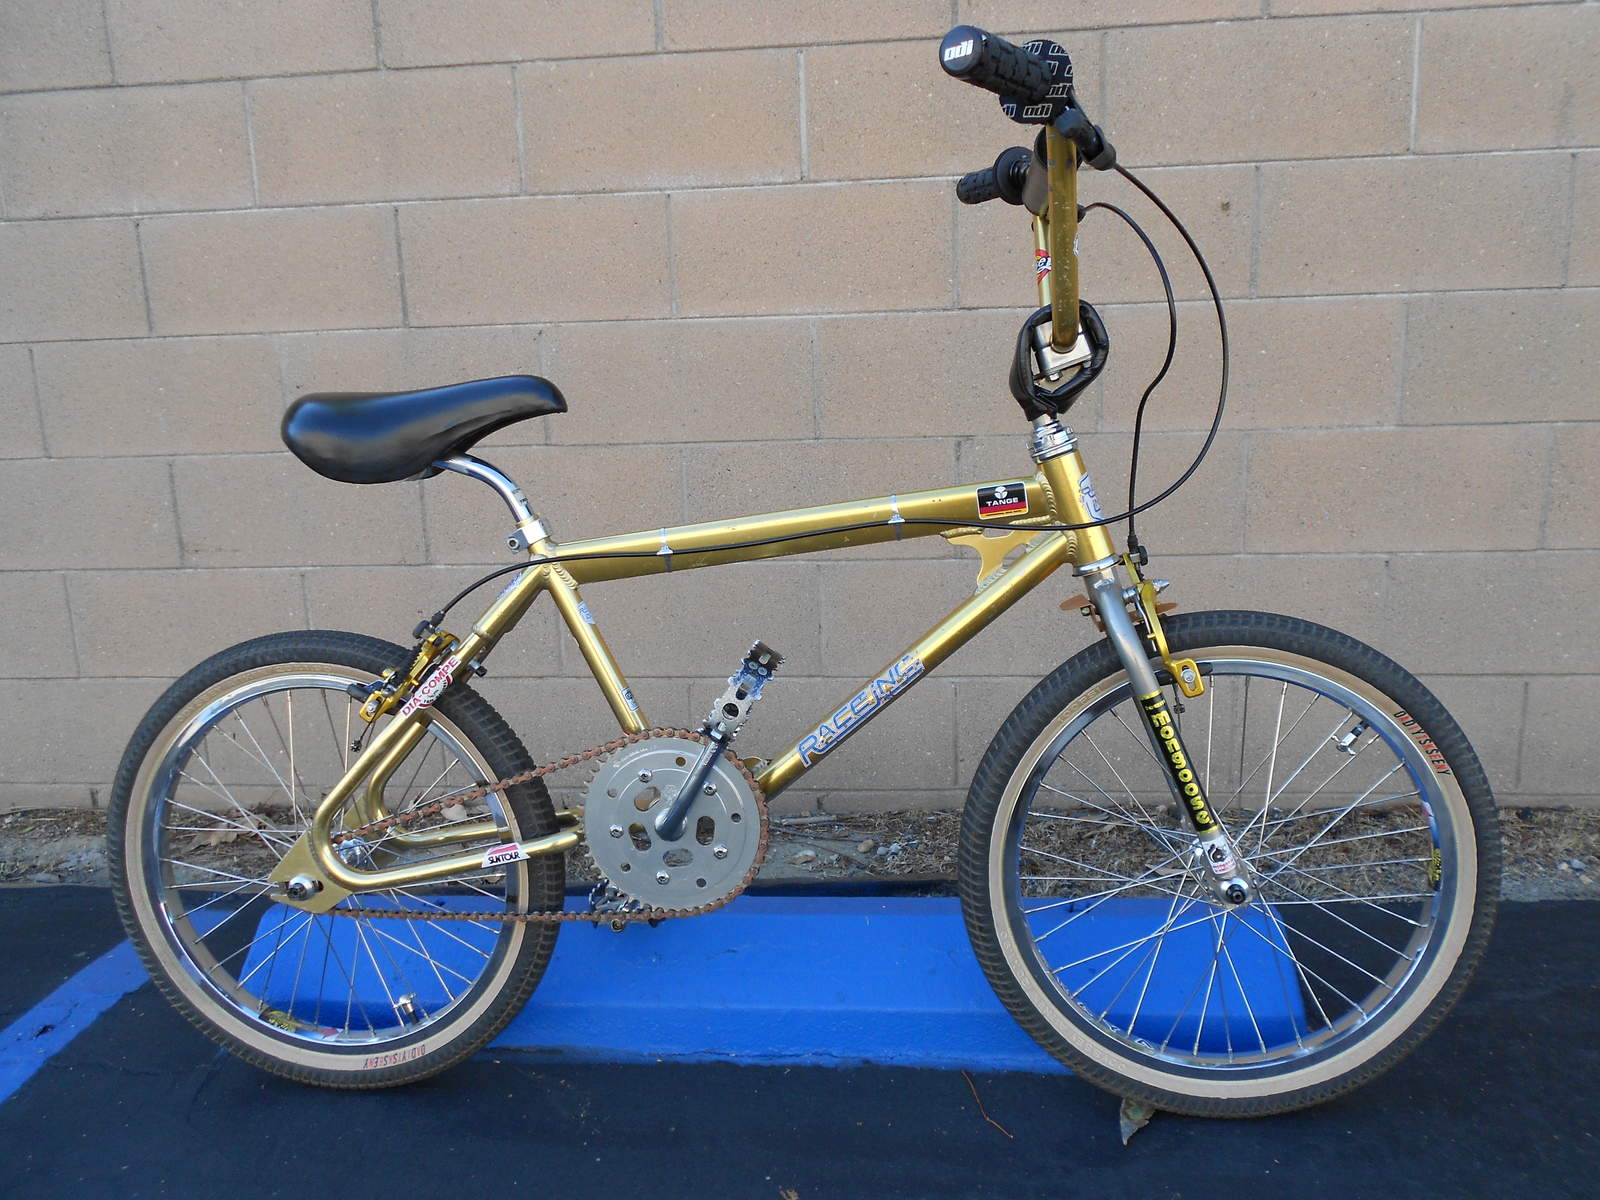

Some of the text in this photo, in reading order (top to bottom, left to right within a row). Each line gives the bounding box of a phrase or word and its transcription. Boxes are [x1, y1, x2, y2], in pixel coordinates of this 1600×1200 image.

[986, 497, 1019, 507] TANGE
[402, 656, 459, 717] DIA-COMPE
[487, 851, 521, 865] SUNTOUR
